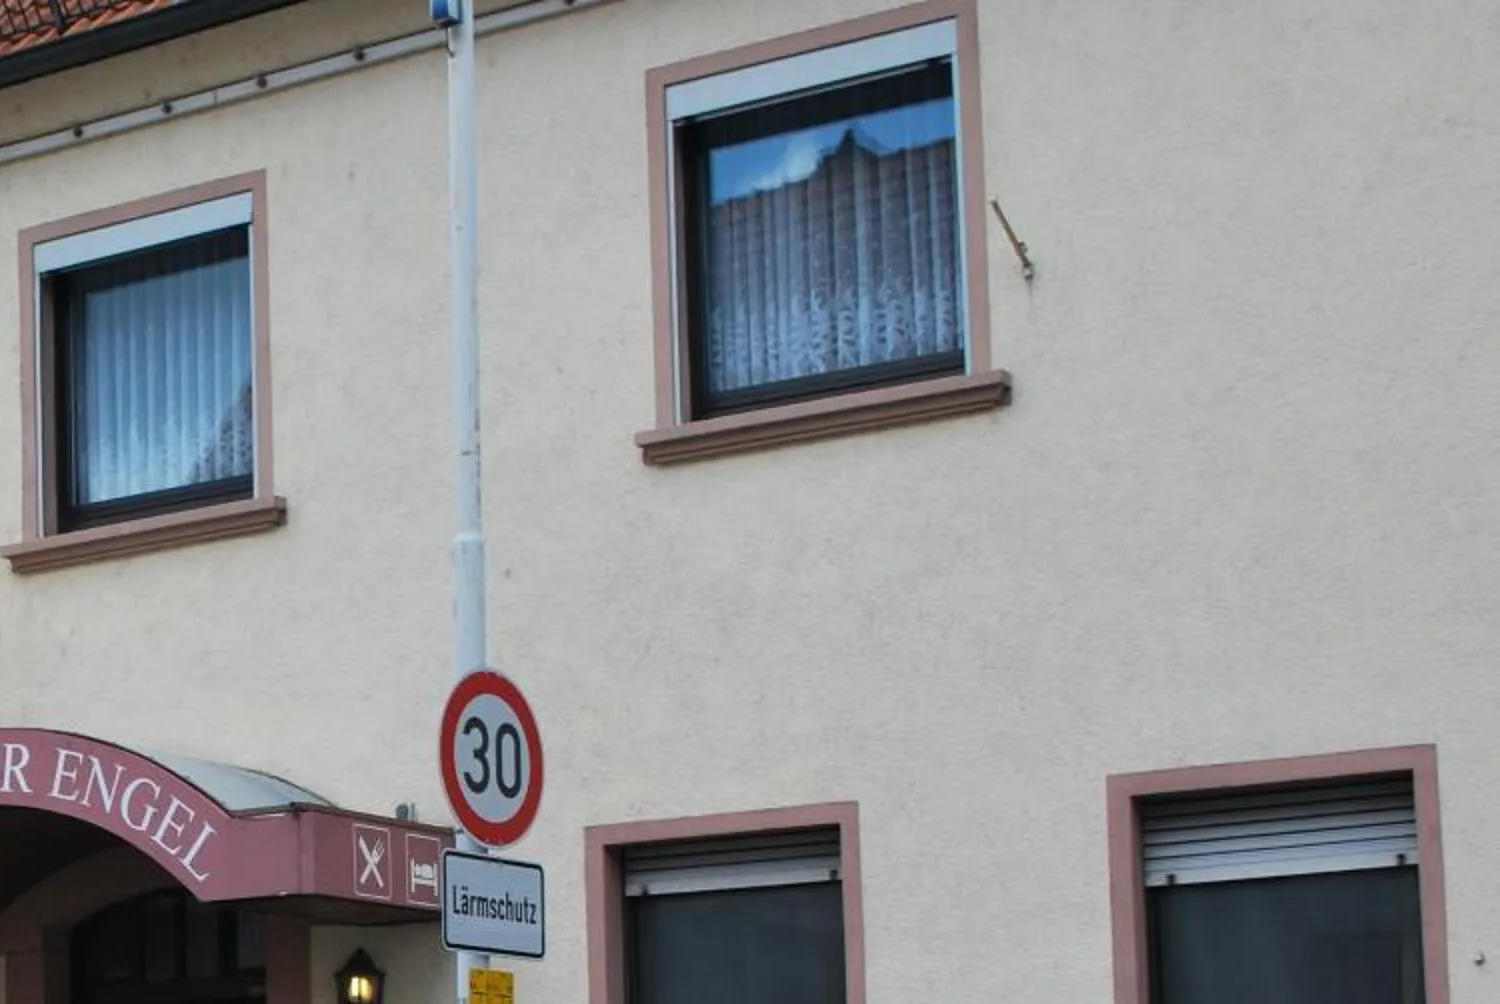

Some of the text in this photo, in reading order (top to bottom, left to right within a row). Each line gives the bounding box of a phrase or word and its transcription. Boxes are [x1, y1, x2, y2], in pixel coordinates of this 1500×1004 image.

[461, 716, 522, 799] 30
[49, 749, 218, 883] ENGEL
[452, 885, 537, 924] Lärmschutz
